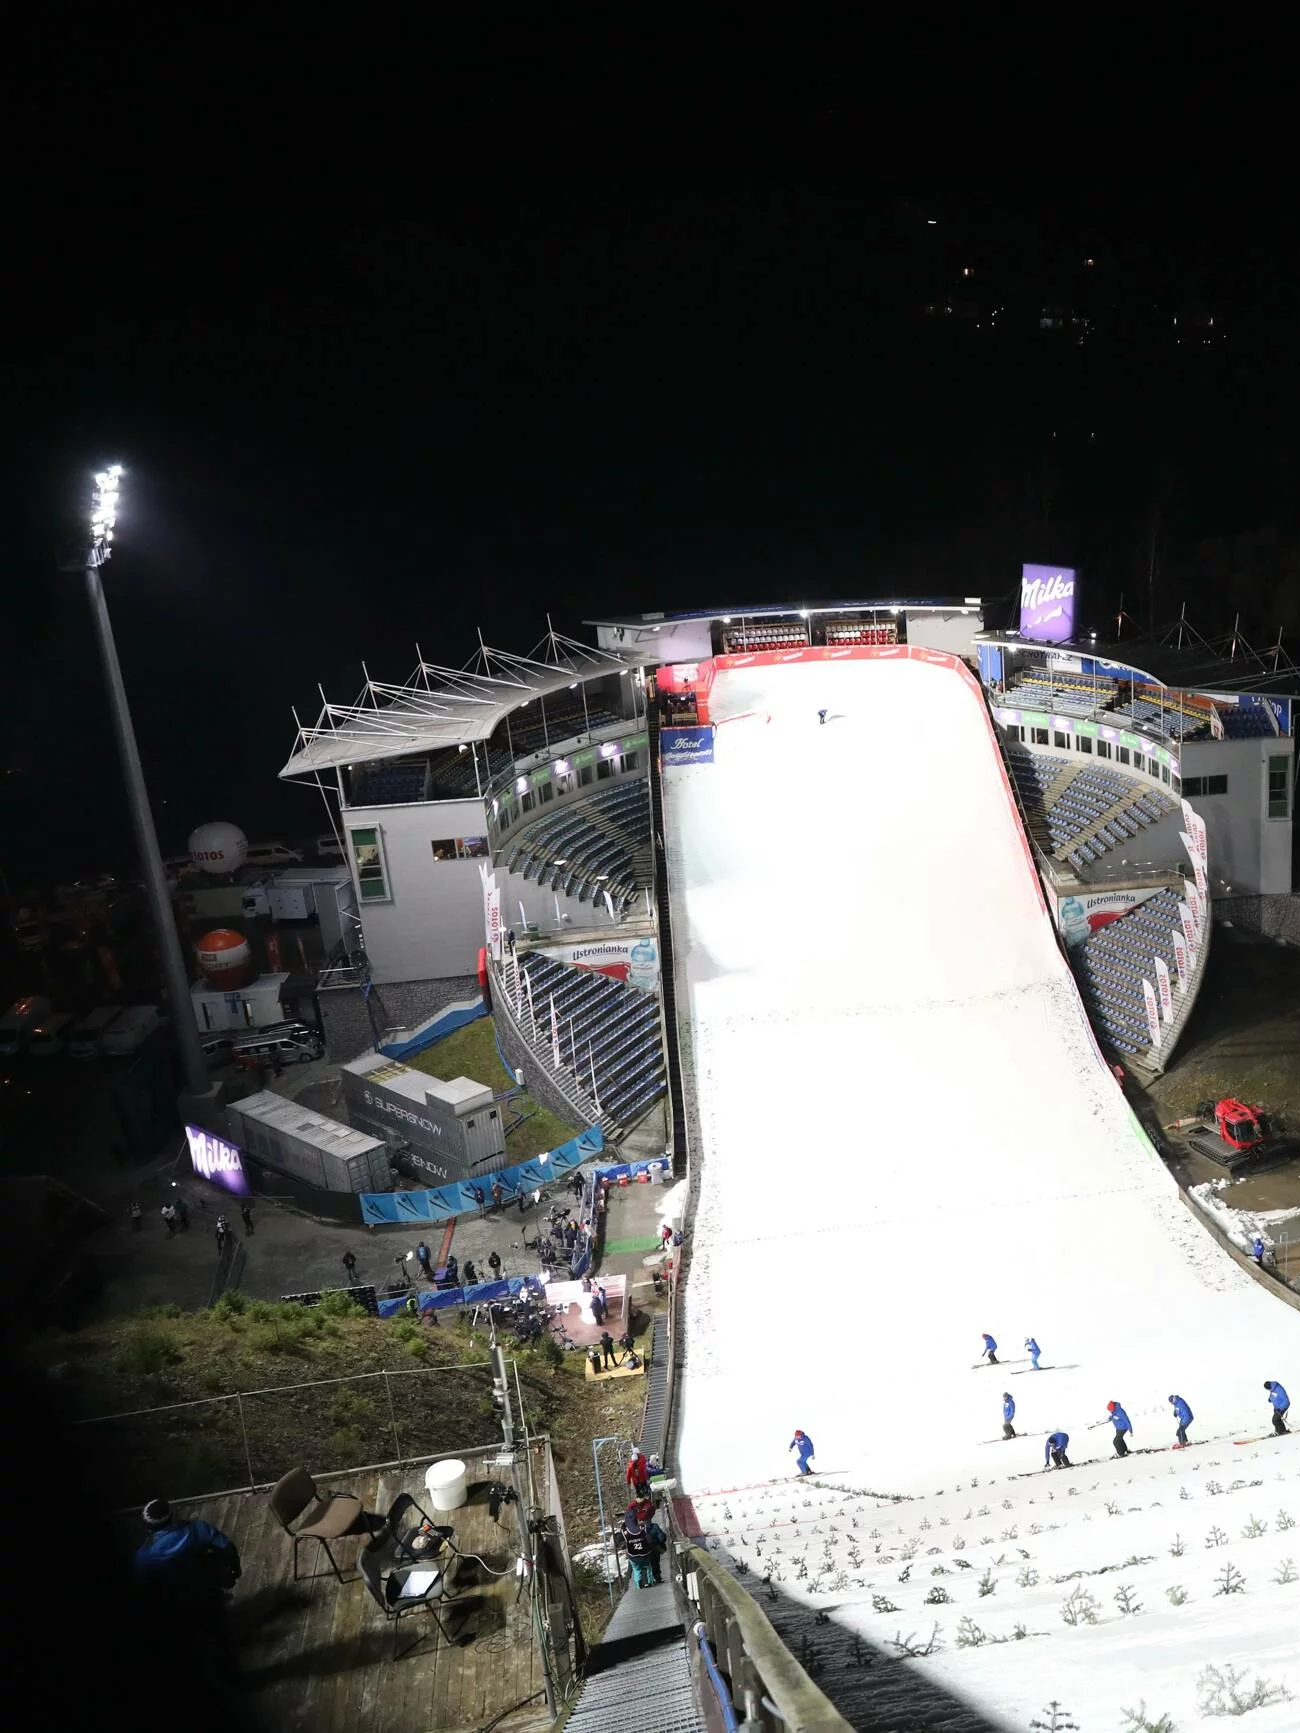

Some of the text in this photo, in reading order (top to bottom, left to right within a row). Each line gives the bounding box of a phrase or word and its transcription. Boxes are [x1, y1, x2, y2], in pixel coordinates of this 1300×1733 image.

[1021, 574, 1074, 610] Milka
[670, 737, 705, 750] Hotel
[1086, 893, 1136, 909] Ustronianka
[491, 907, 499, 931] LOTOS
[573, 943, 629, 961] Ustronianka
[375, 1097, 442, 1136] SUPERSNOW
[185, 1126, 242, 1179] Milka
